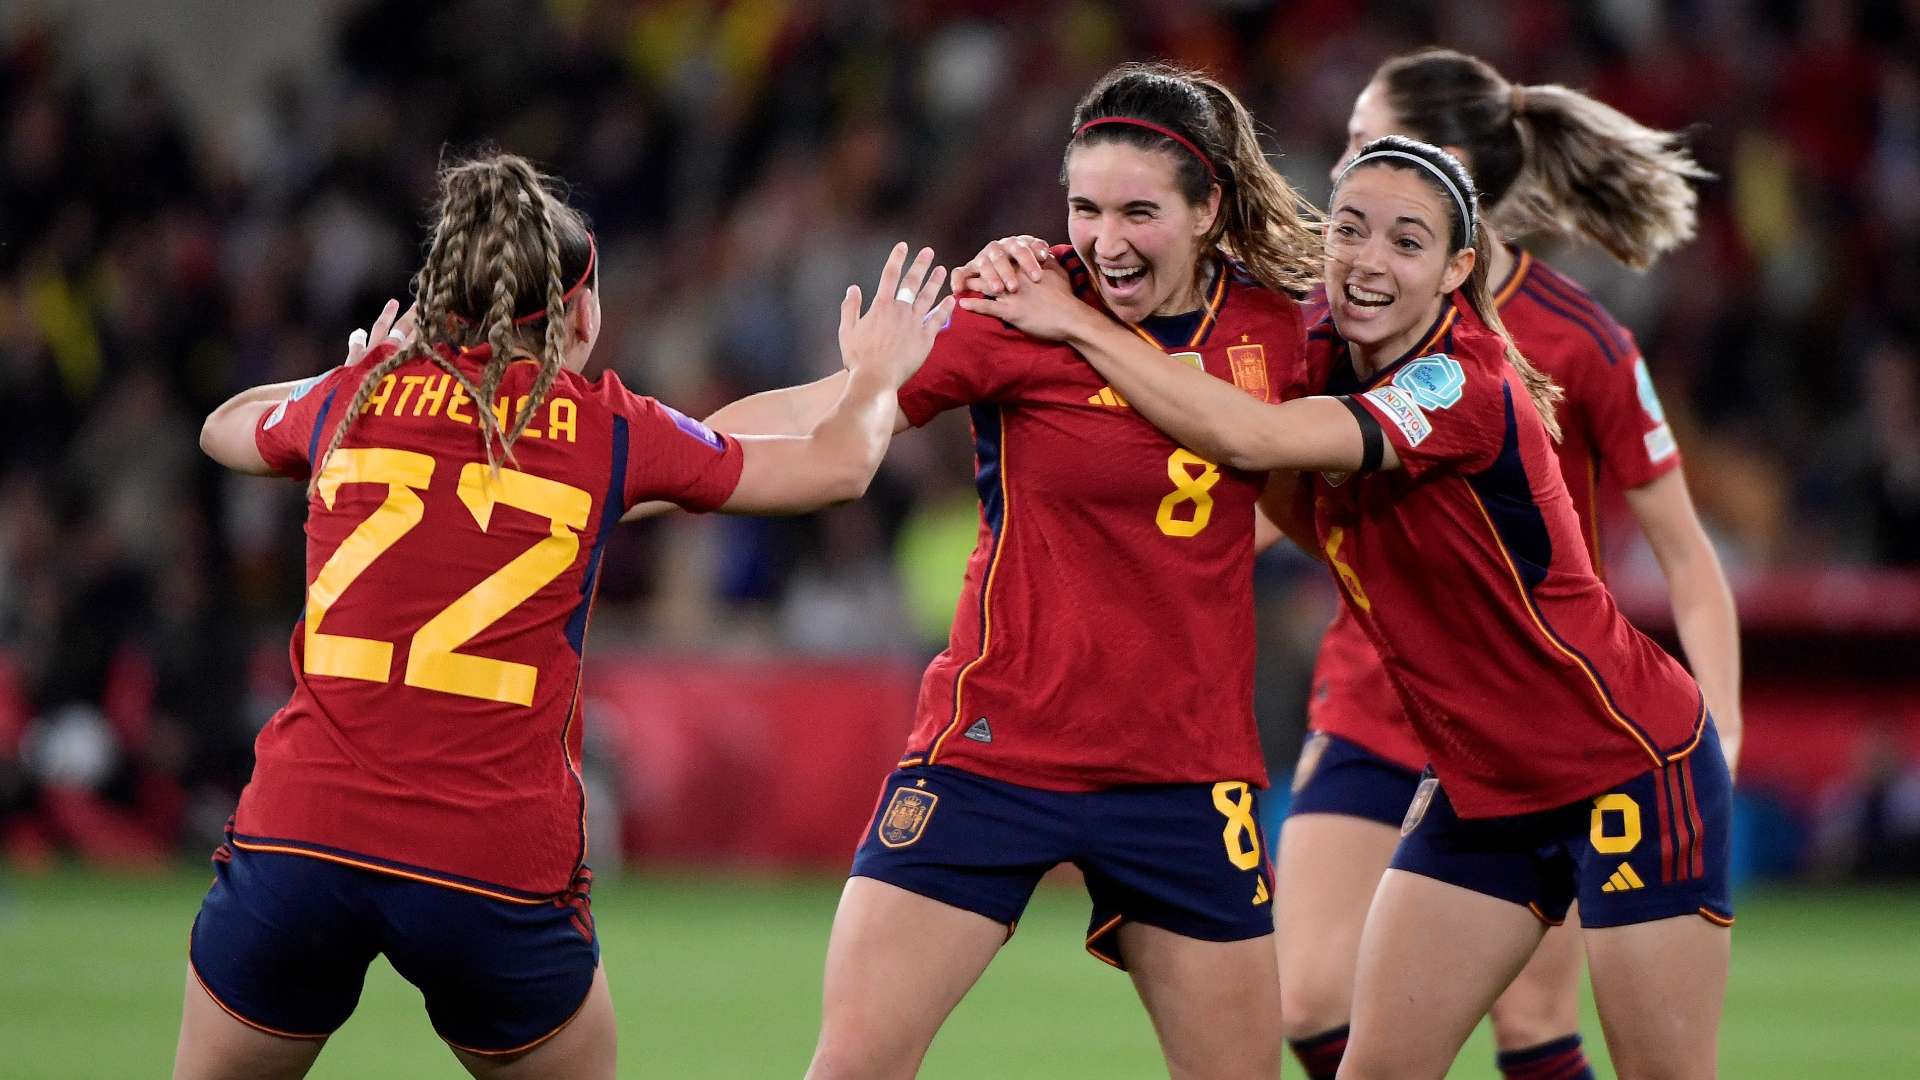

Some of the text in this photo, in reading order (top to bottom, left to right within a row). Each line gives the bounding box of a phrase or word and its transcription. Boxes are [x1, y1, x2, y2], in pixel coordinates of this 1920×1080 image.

[1376, 390, 1426, 439] UNDATION
[1156, 448, 1220, 538] 8
[304, 448, 592, 707] 22
[1211, 780, 1260, 872] 8
